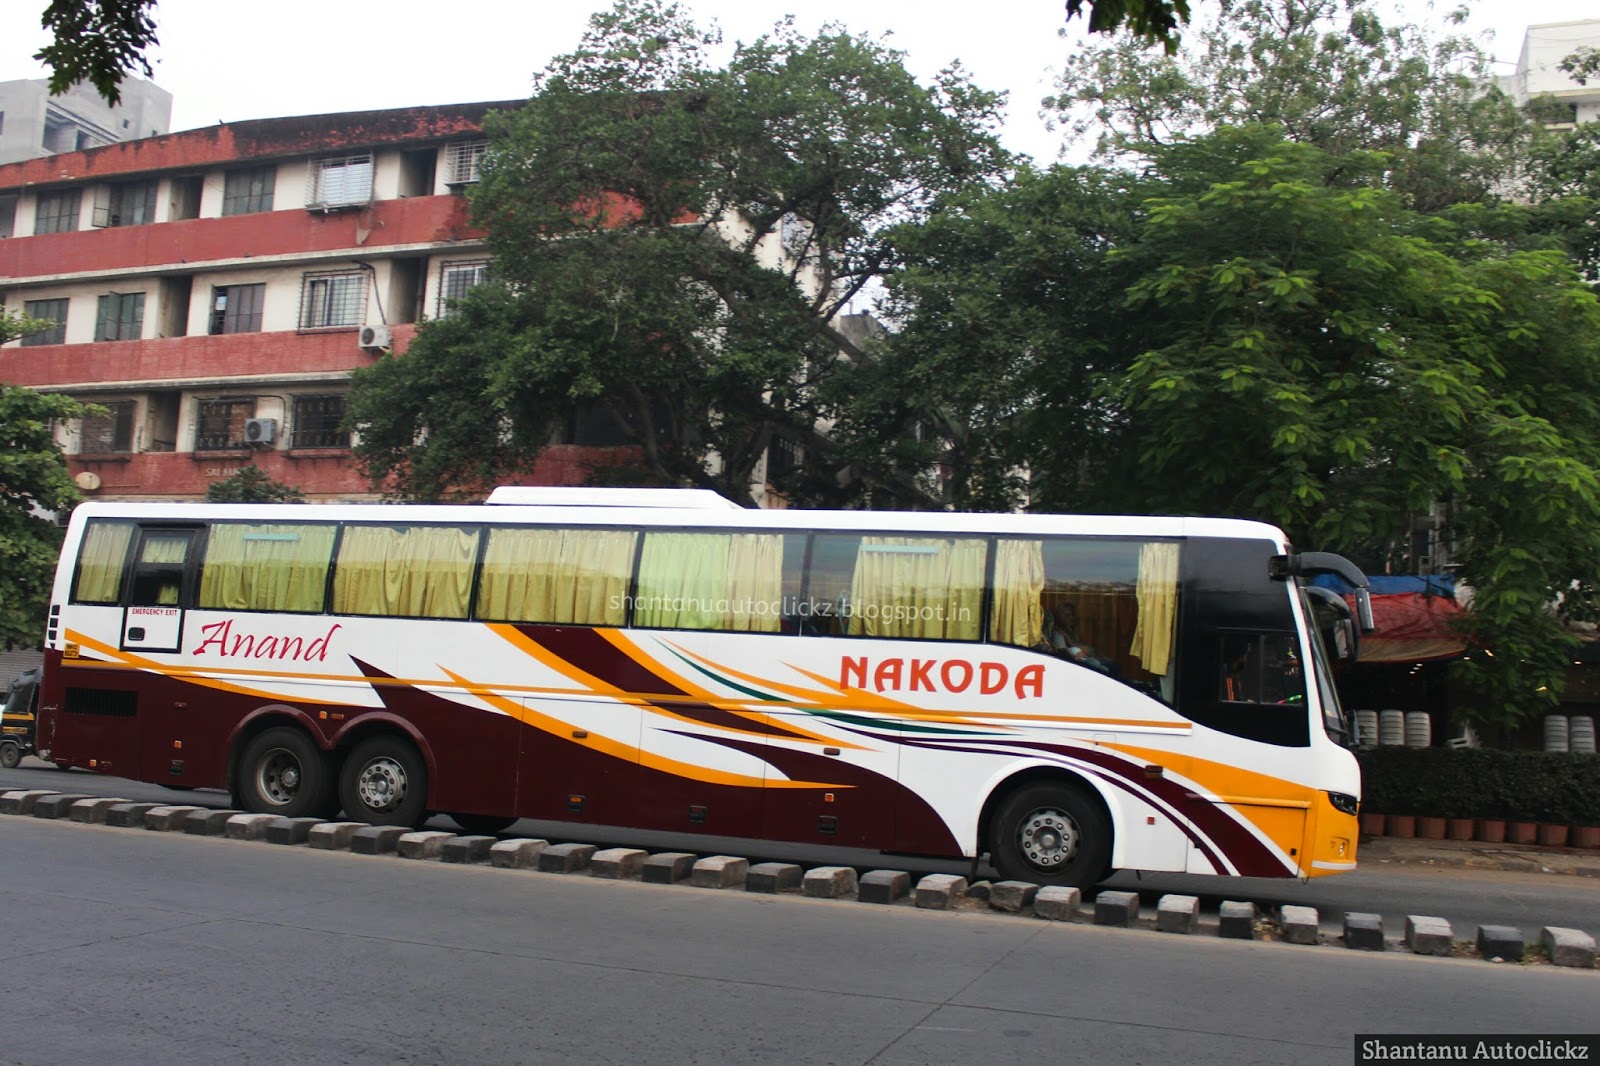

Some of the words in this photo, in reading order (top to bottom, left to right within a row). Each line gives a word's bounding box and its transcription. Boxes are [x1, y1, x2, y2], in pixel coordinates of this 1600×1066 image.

[132, 608, 163, 616] EMERGENCY
[193, 619, 342, 662] Anand
[840, 656, 1046, 700] NAKODA
